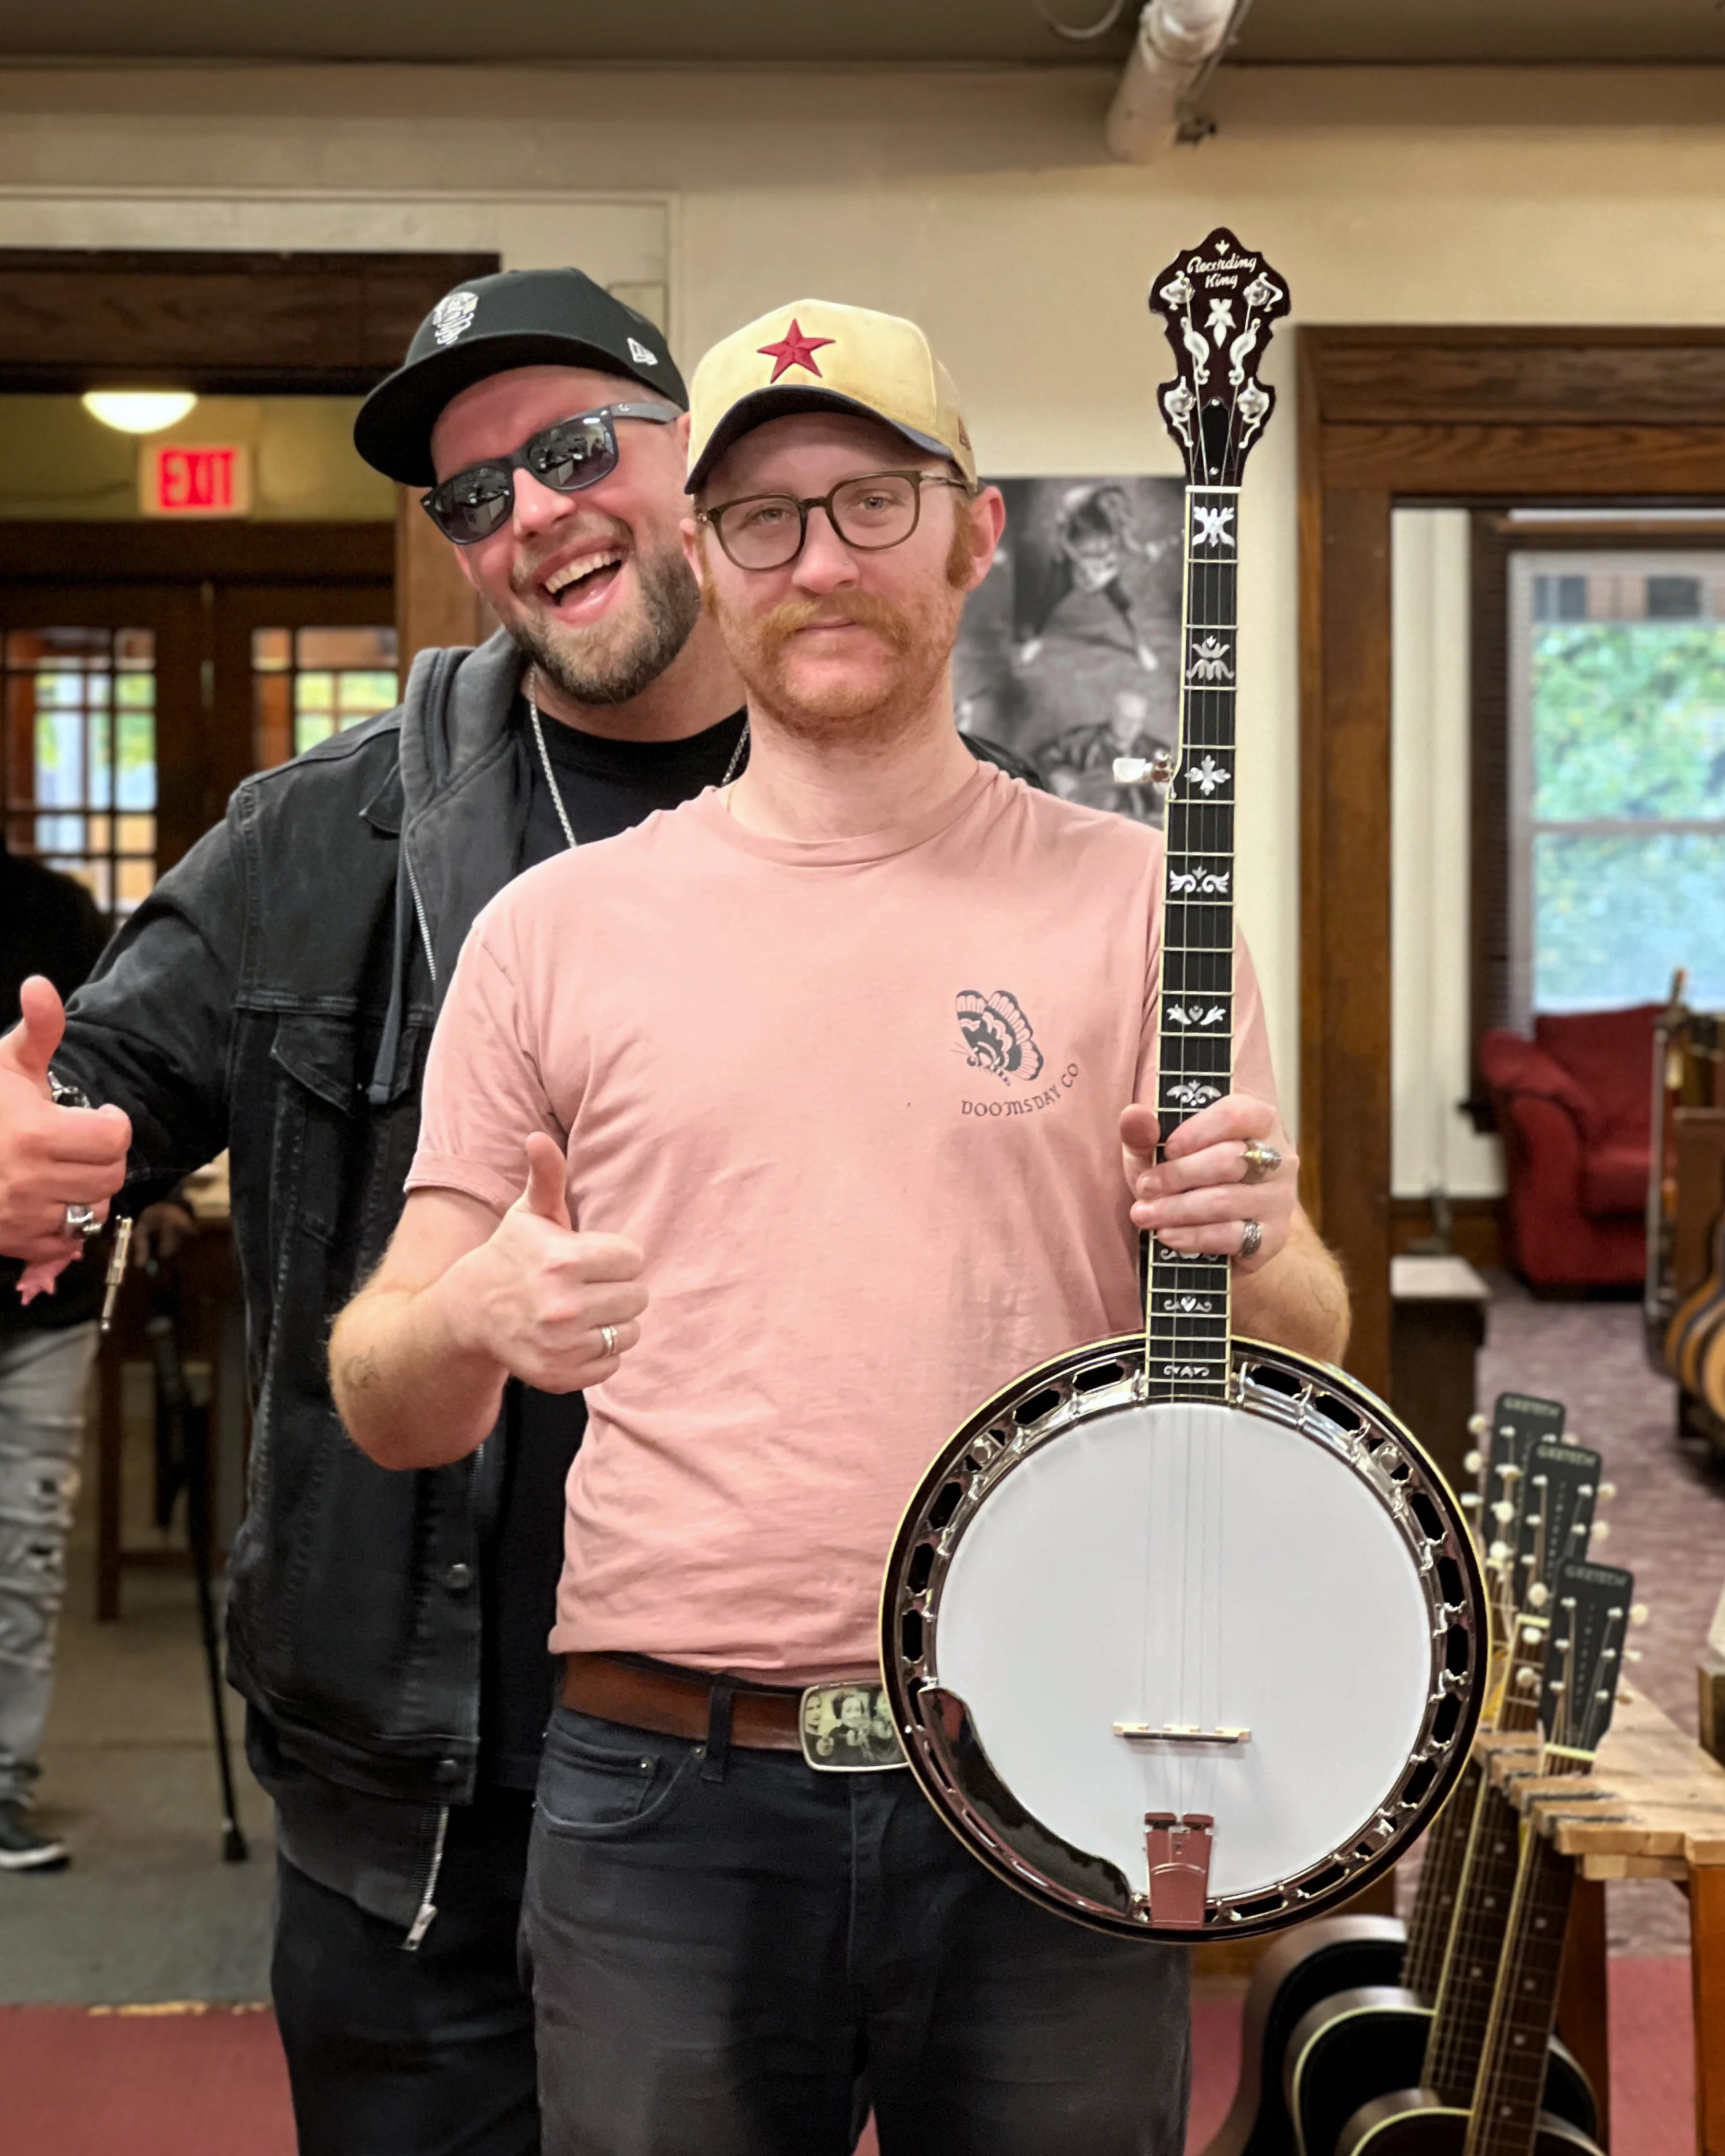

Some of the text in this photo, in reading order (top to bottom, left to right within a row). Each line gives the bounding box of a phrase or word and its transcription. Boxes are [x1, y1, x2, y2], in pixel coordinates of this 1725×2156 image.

[1186, 253, 1257, 274] Recording
[1204, 272, 1238, 289] King
[160, 450, 234, 507] EXIT
[961, 1063, 1079, 1117] DOOMSDAY CO
